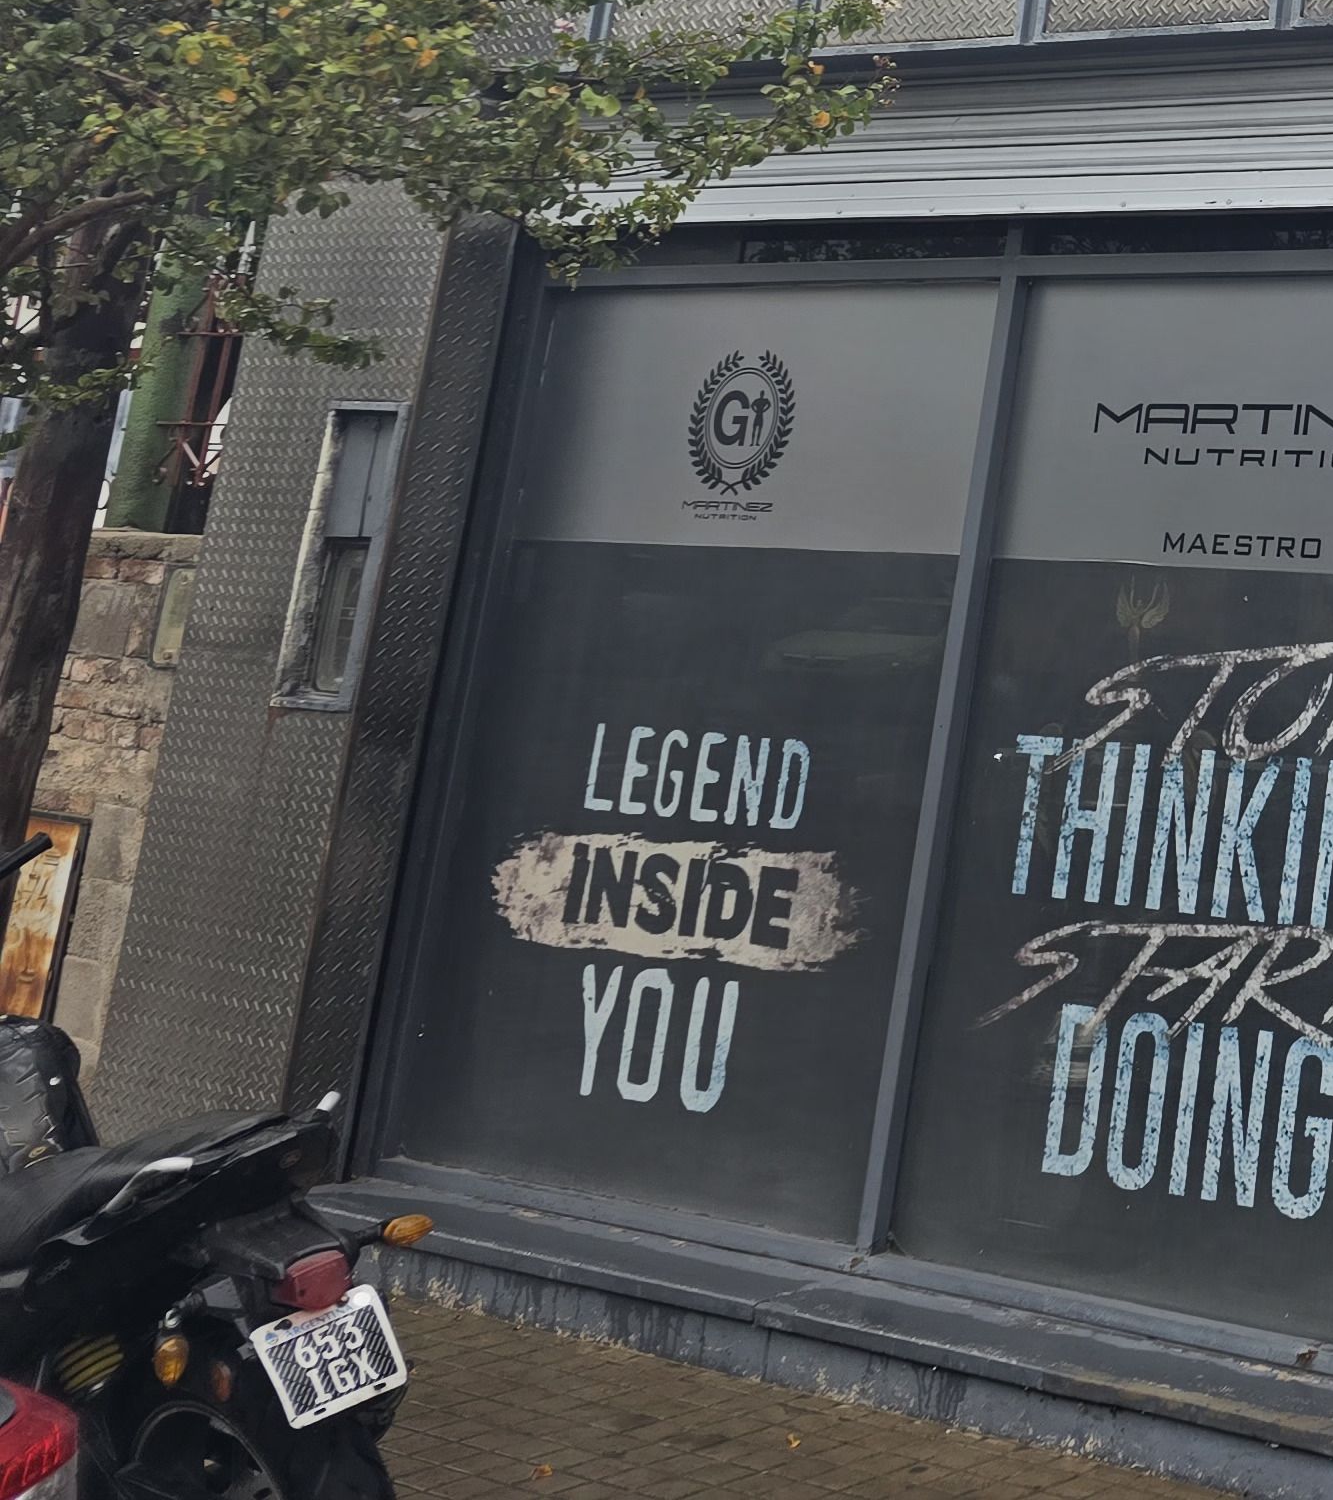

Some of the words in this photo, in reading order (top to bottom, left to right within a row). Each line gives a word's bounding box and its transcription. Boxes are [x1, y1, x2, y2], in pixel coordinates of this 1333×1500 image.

[681, 500, 774, 512] MARTINEZ
[1162, 531, 1321, 560] MAESTRO
[584, 723, 810, 830] LEGEND
[562, 842, 799, 950] INSIDE
[579, 964, 740, 1113] YOU
[295, 1316, 364, 1368] 653
